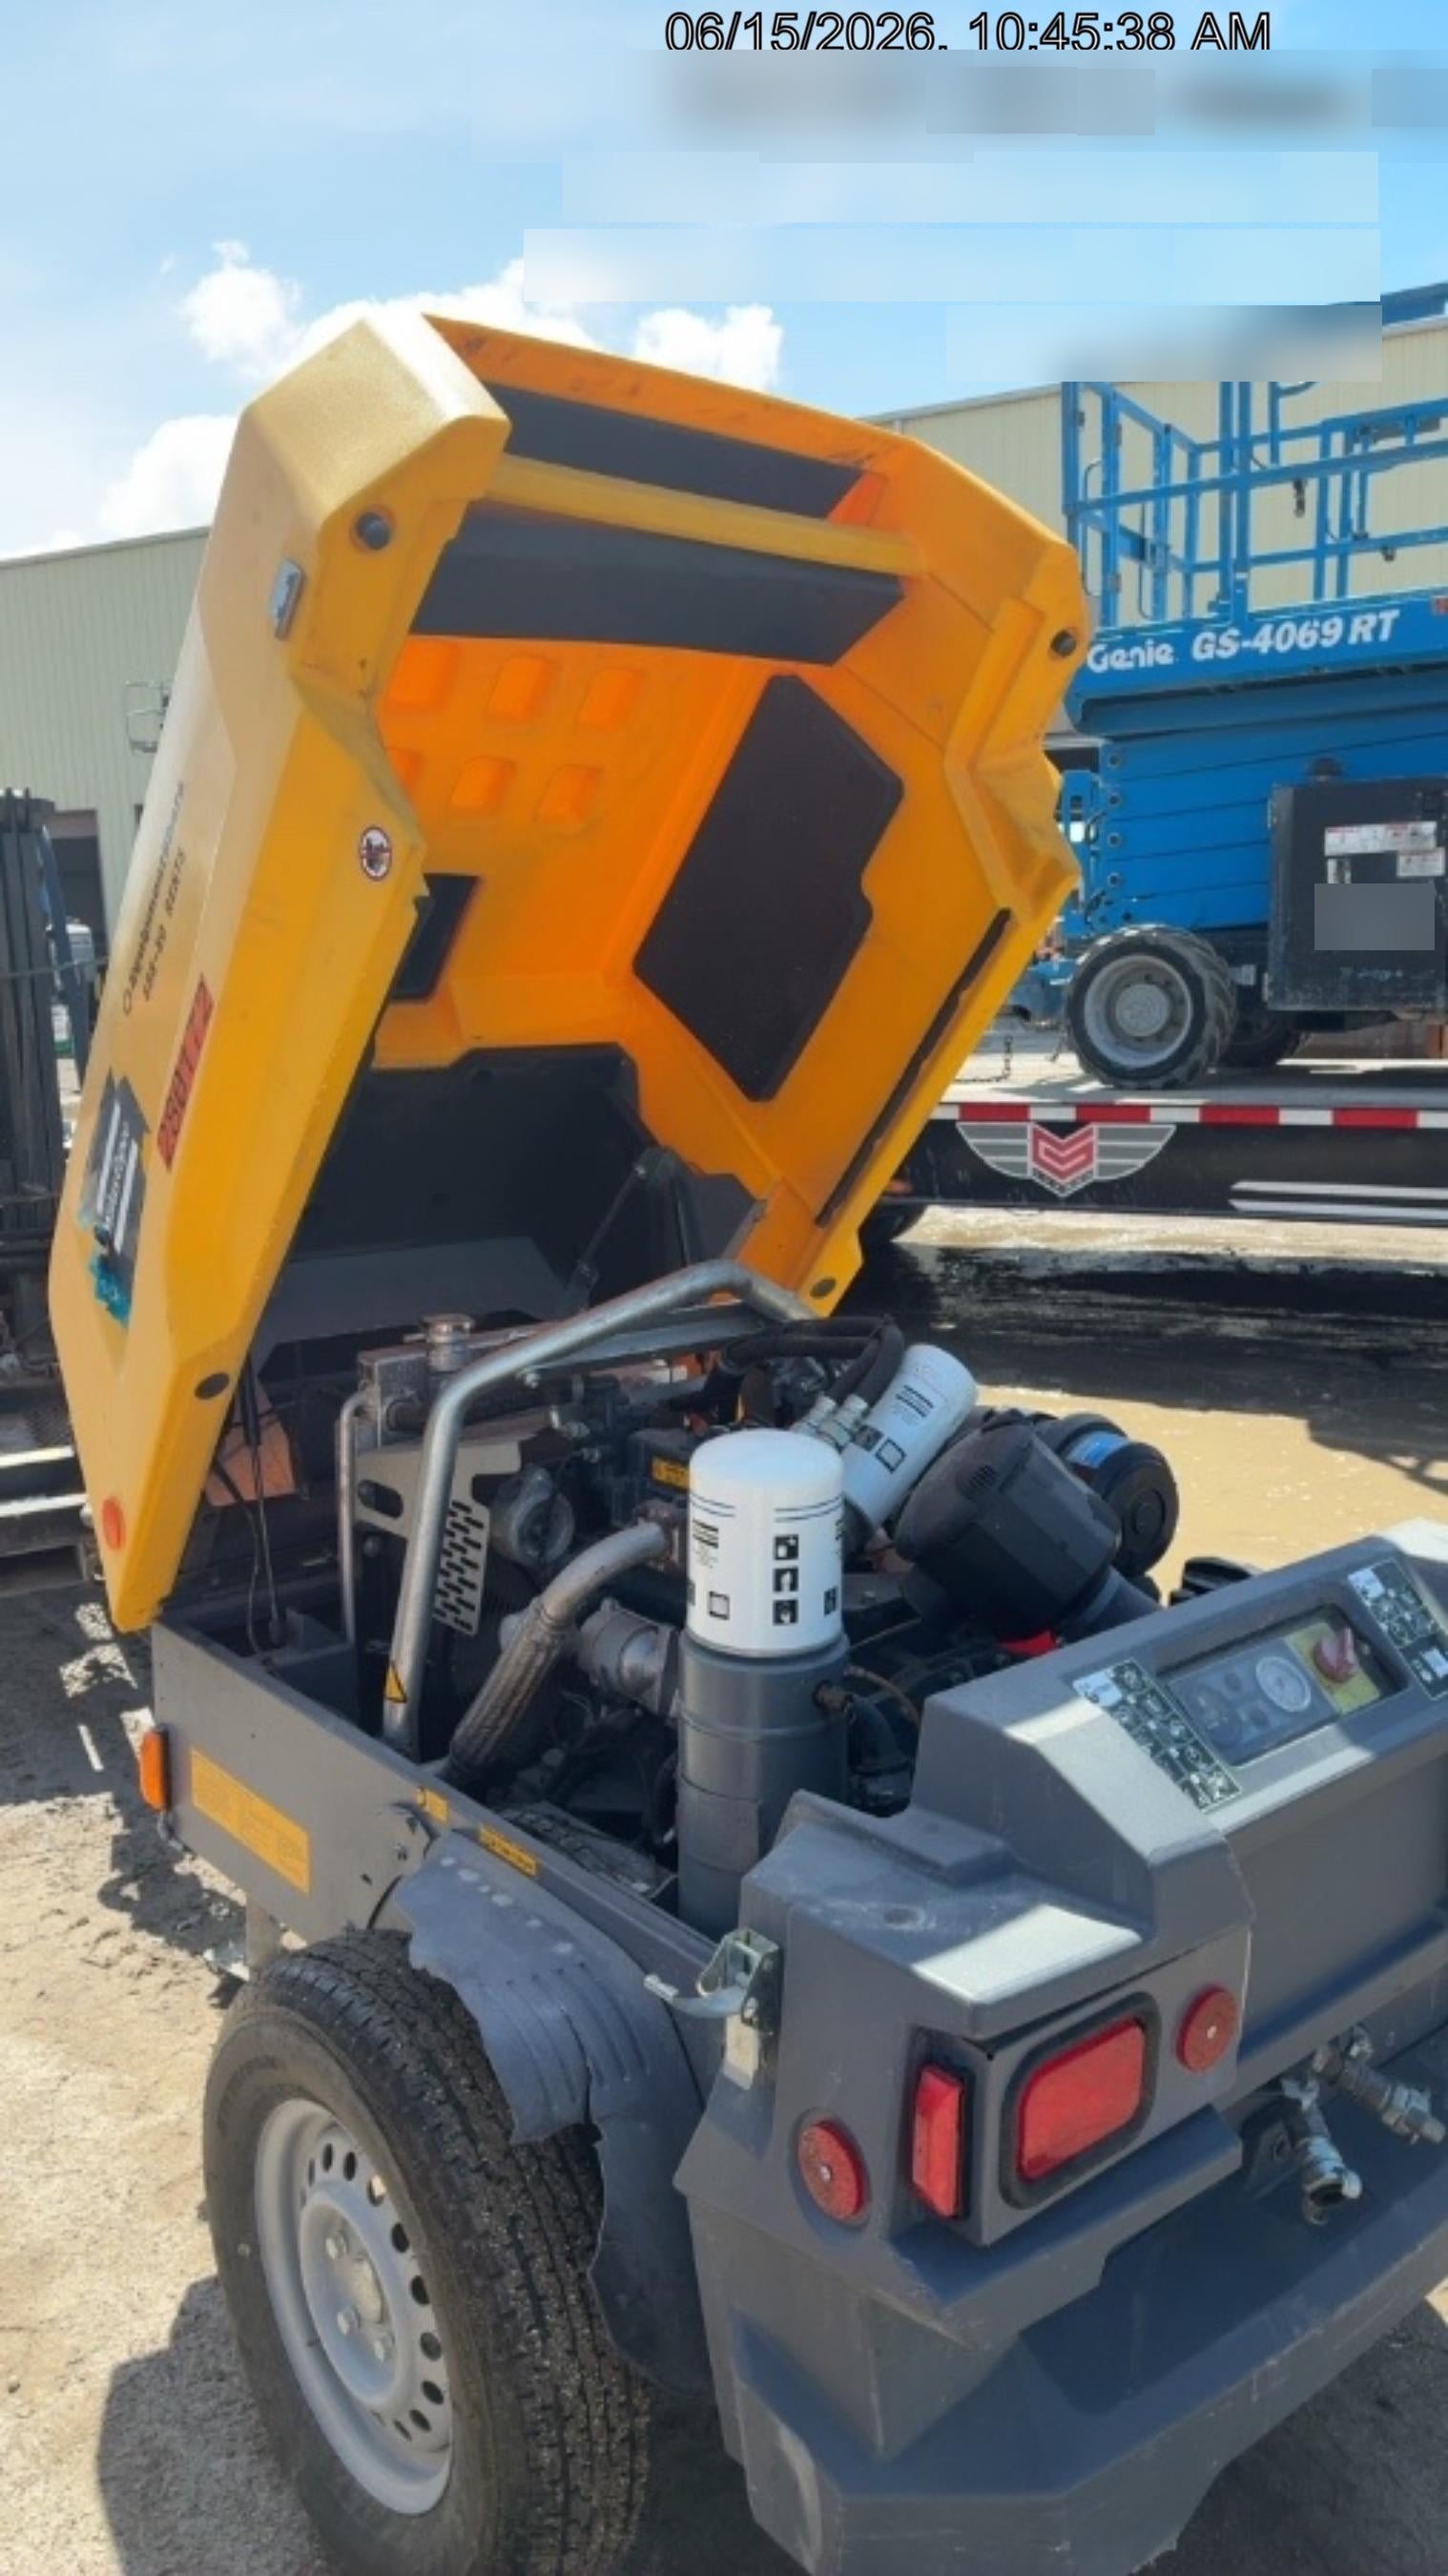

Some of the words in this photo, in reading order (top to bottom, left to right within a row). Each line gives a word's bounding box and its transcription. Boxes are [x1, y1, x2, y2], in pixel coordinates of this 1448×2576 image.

[1086, 640, 1174, 674] Genie
[1192, 616, 1343, 662] GS-4069
[1347, 610, 1400, 645] RT
